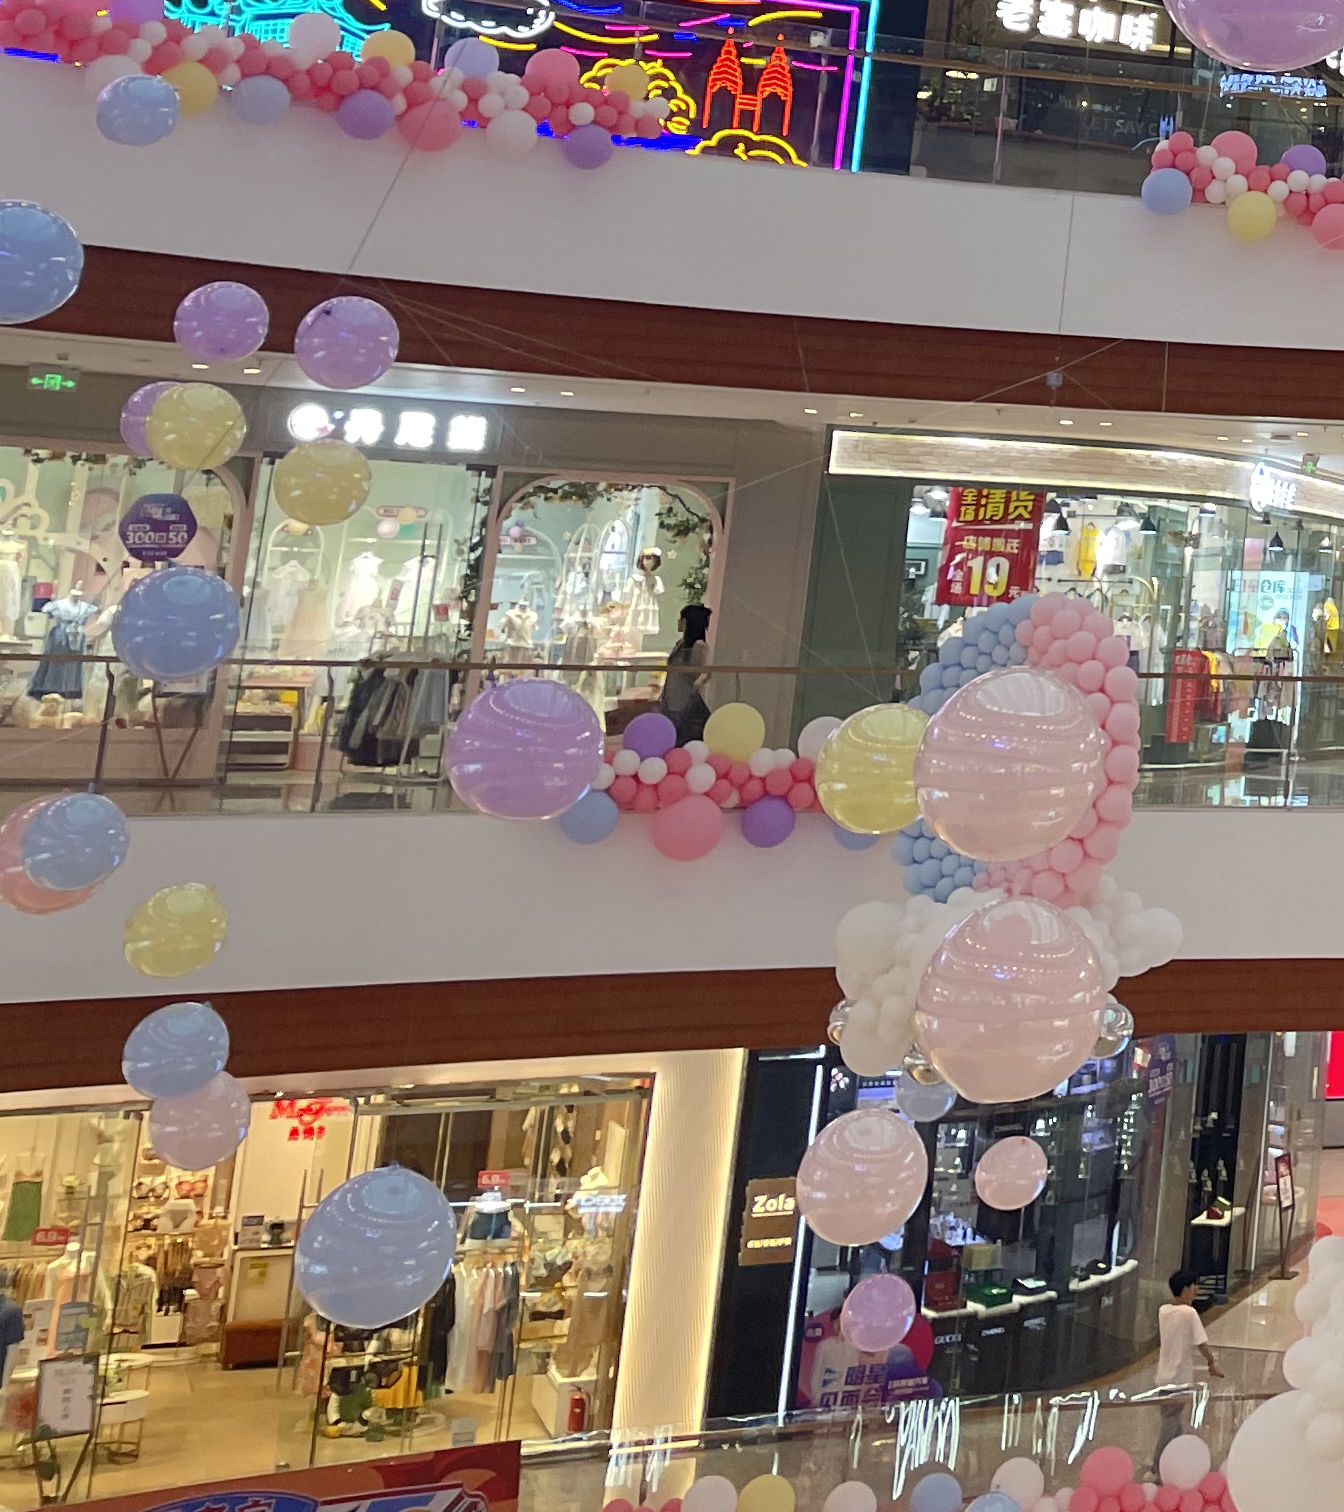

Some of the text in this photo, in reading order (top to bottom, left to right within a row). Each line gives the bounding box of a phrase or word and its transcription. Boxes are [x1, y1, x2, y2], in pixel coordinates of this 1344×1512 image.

[967, 555, 1011, 597] 19
[751, 1193, 797, 1215] Zola
[934, 1333, 962, 1345] GUCCI
